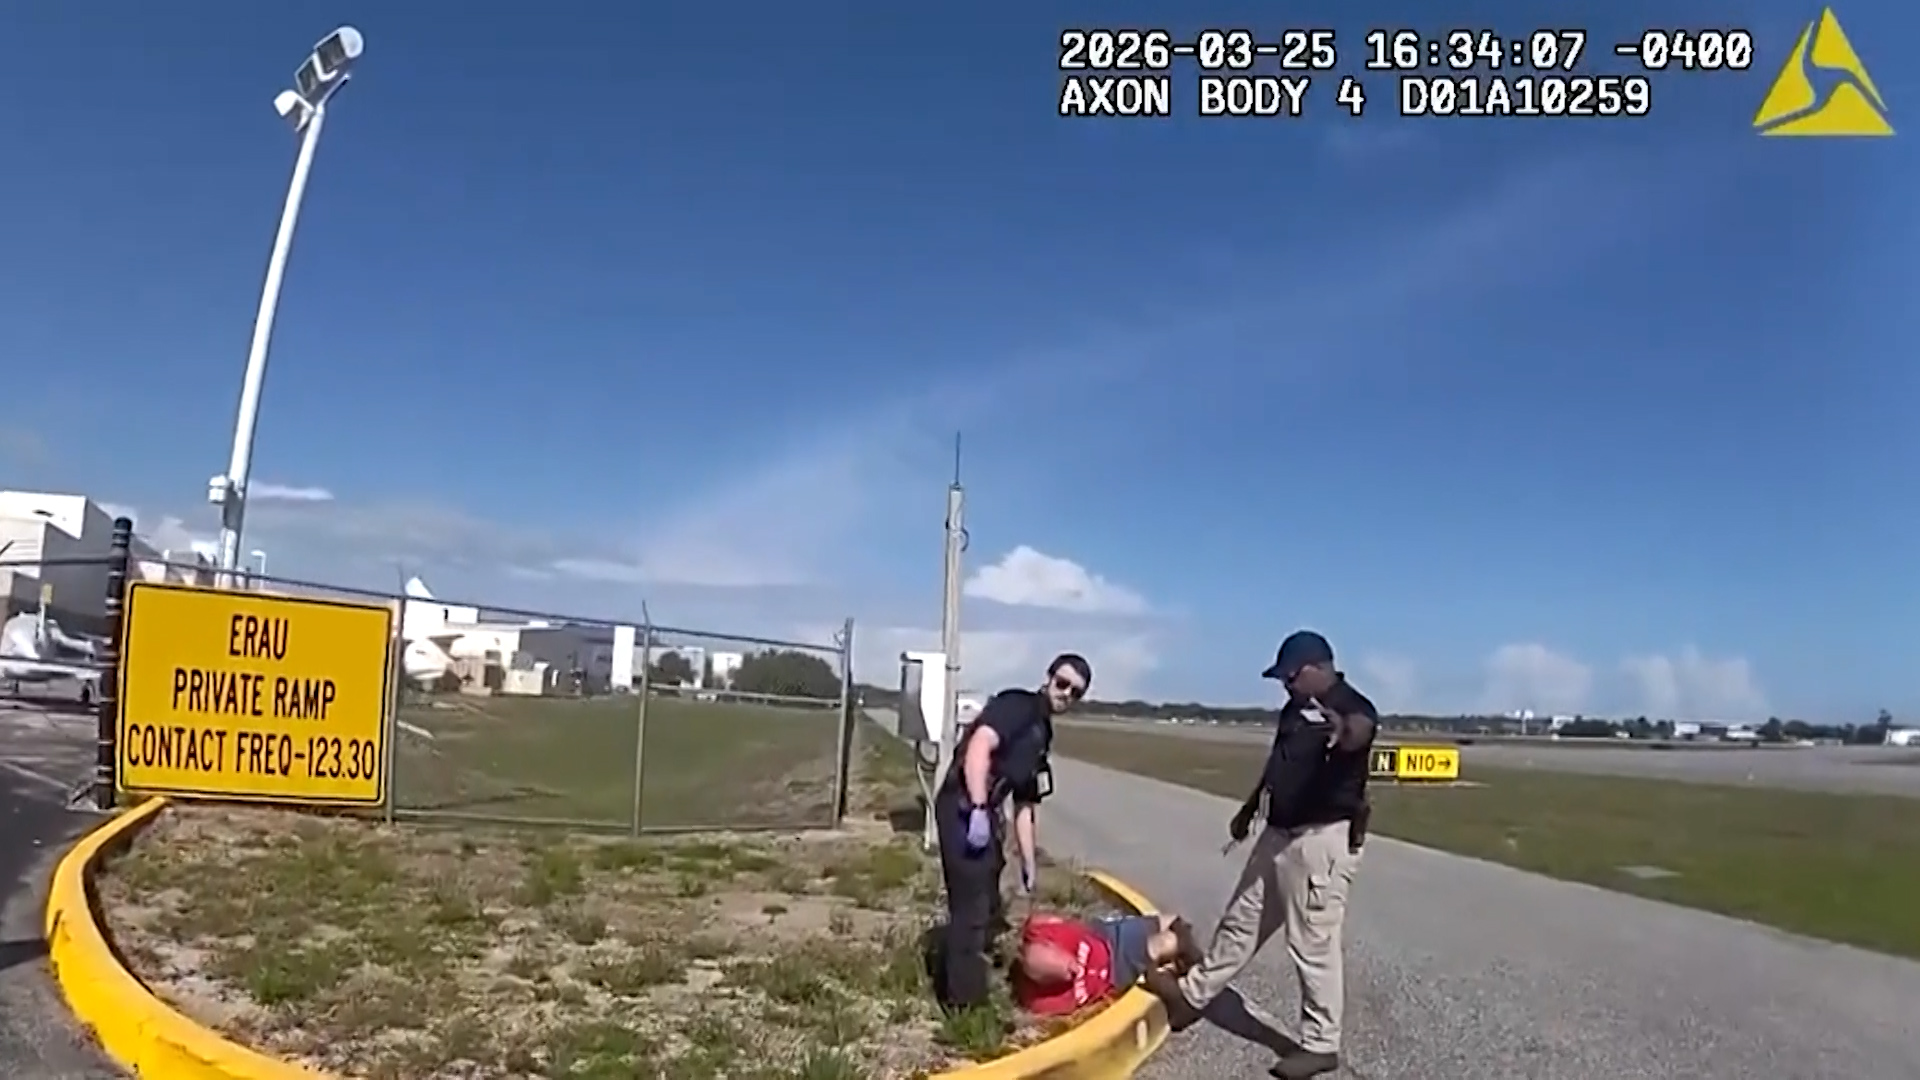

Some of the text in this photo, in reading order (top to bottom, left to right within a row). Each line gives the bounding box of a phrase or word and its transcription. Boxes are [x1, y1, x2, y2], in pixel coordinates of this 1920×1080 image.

[229, 614, 288, 660] ERAU
[172, 668, 336, 720] PRIVATE RAMP
[128, 724, 375, 780] CONTACT FREQ-123.30
[1377, 752, 1435, 772] N N10
